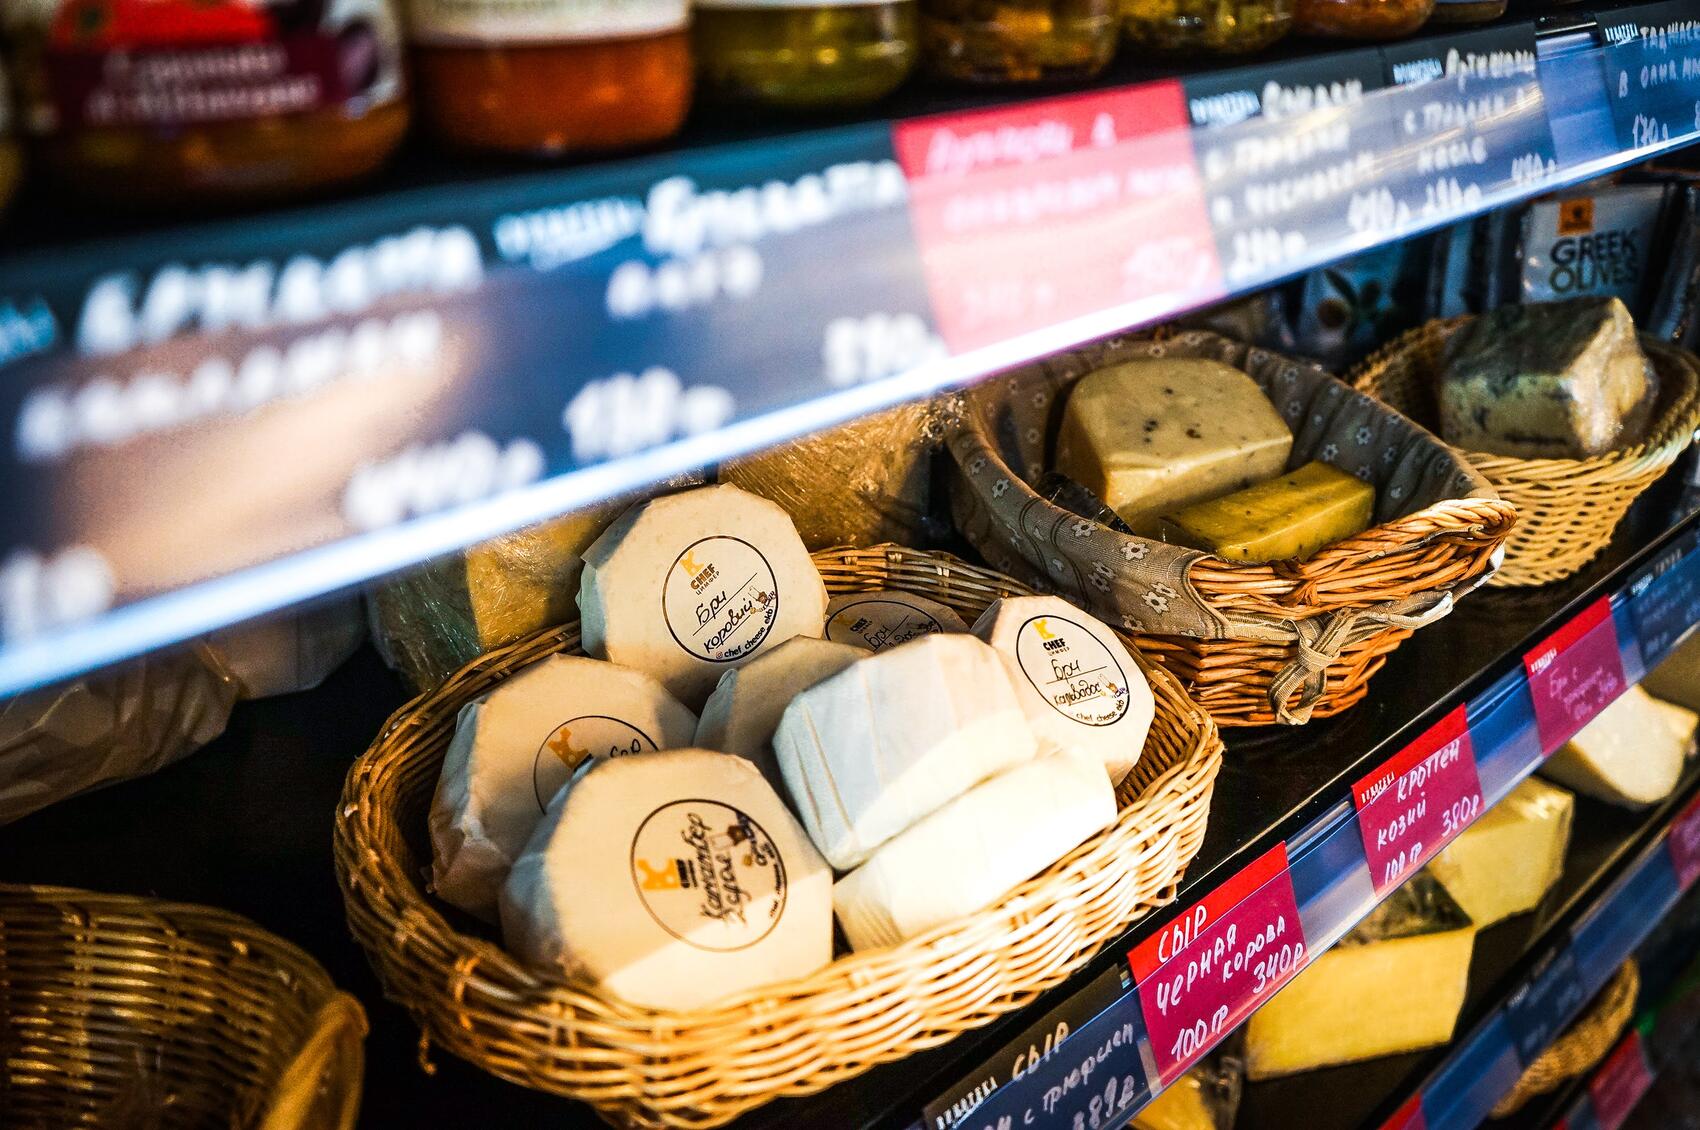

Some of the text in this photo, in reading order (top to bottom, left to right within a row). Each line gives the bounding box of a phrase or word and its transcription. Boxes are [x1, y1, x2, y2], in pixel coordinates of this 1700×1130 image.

[1550, 229, 1638, 266] GREEK
[1549, 258, 1639, 293] OLIVES
[690, 563, 716, 590] CHEF
[1042, 637, 1067, 651] CHEF
[1158, 904, 1207, 964] СЫР
[1223, 915, 1286, 983] КОРОВА
[1012, 1021, 1070, 1081] СЫР
[1171, 1018, 1208, 1062] 100
